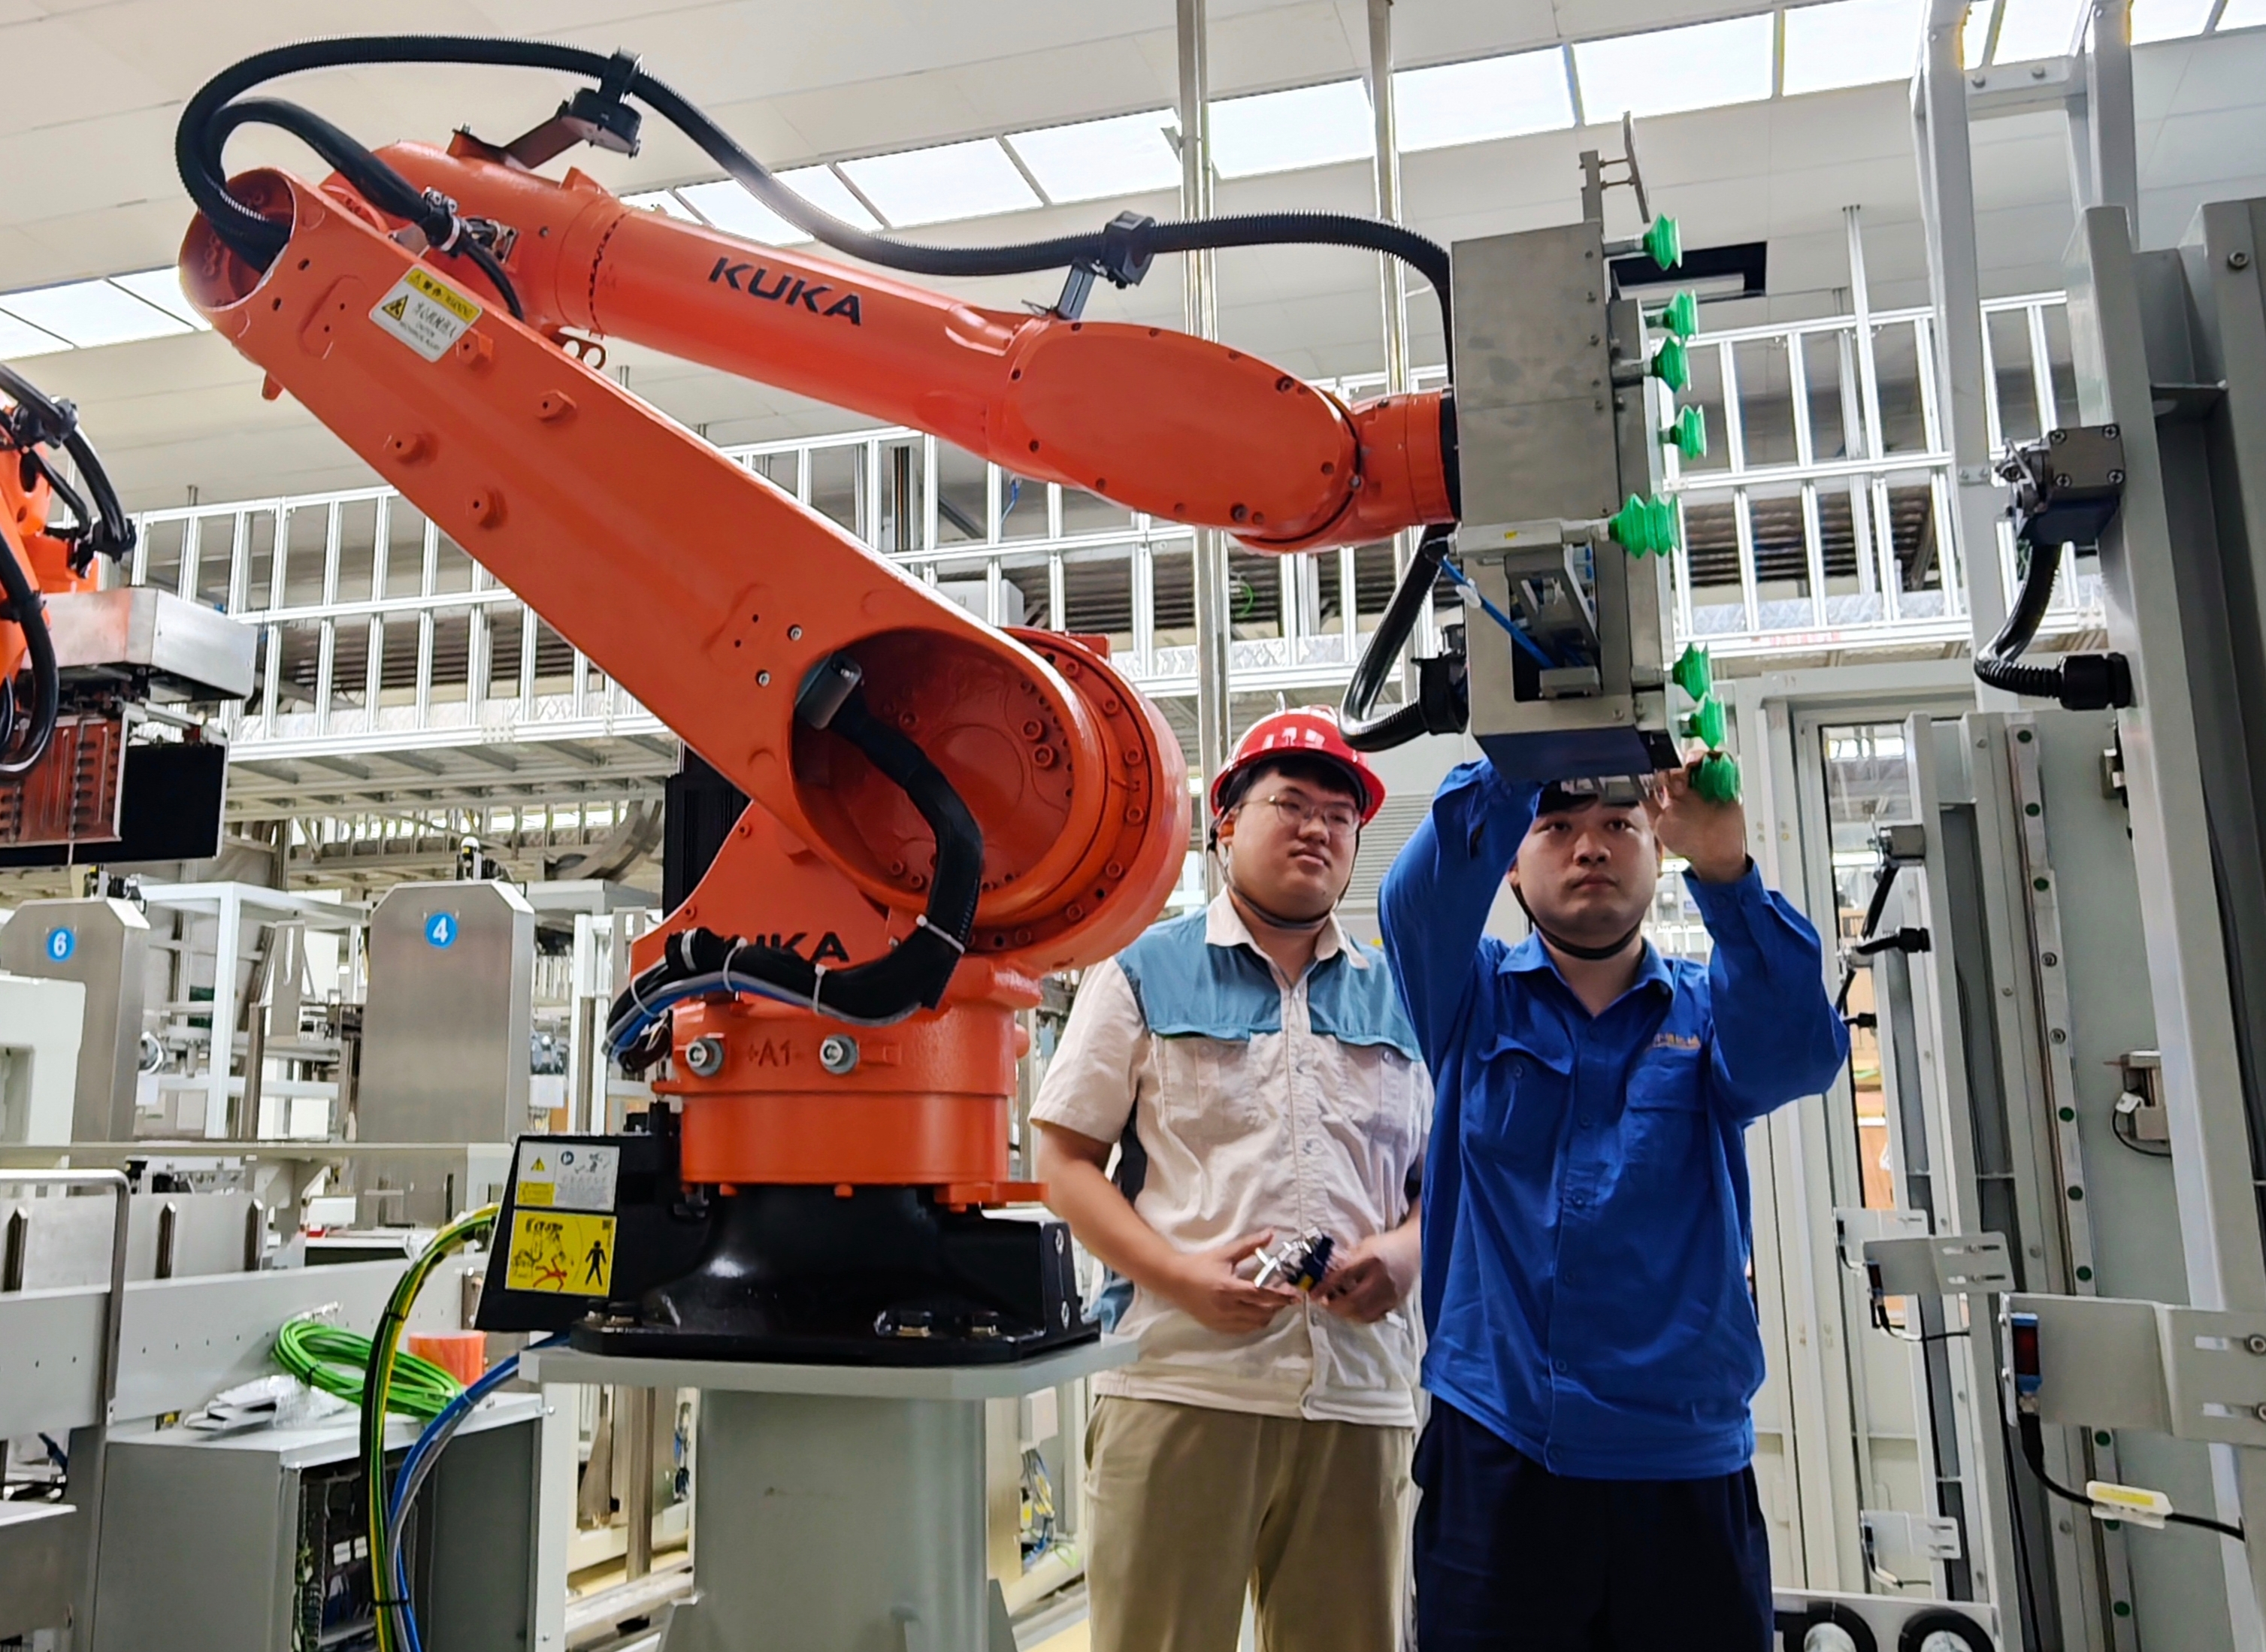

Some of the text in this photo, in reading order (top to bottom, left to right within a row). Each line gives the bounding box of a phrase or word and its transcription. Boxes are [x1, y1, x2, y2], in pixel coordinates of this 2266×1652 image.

[708, 256, 862, 326] KUKA
[433, 916, 449, 942] 4
[53, 931, 67, 957] 6
